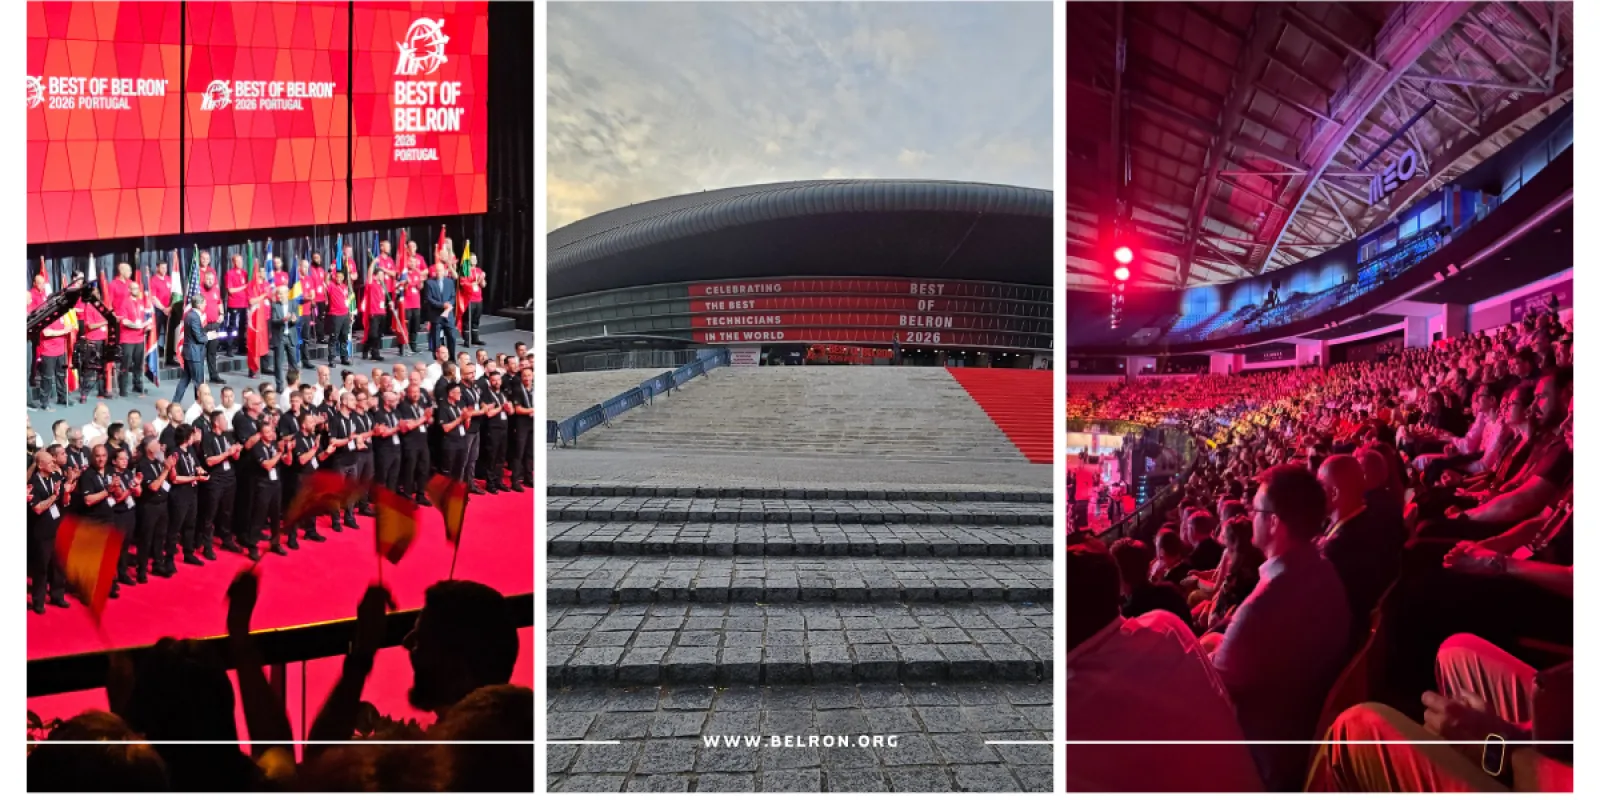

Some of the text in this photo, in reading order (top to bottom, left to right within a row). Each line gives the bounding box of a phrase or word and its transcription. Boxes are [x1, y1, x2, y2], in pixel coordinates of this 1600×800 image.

[48, 76, 87, 95] BEST
[89, 77, 108, 95] OF
[235, 80, 267, 97] BEST
[268, 81, 285, 97] OF
[394, 80, 462, 106] BEST OF
[48, 96, 132, 109] 2026 PORTUGAL
[235, 98, 304, 110] 2026 PORTUGAL
[394, 133, 417, 147] 2026
[394, 147, 439, 161] PORTUGAL
[1368, 147, 1417, 206] MEO
[705, 283, 782, 295] CELEBRATING
[910, 283, 945, 295] BEST
[705, 300, 756, 310] THE BEST
[917, 299, 935, 311] OF
[705, 315, 782, 326] TECHNICIANS
[899, 315, 953, 328] BELRON
[704, 331, 785, 341] IN THE WORLD
[906, 331, 941, 344] 2026
